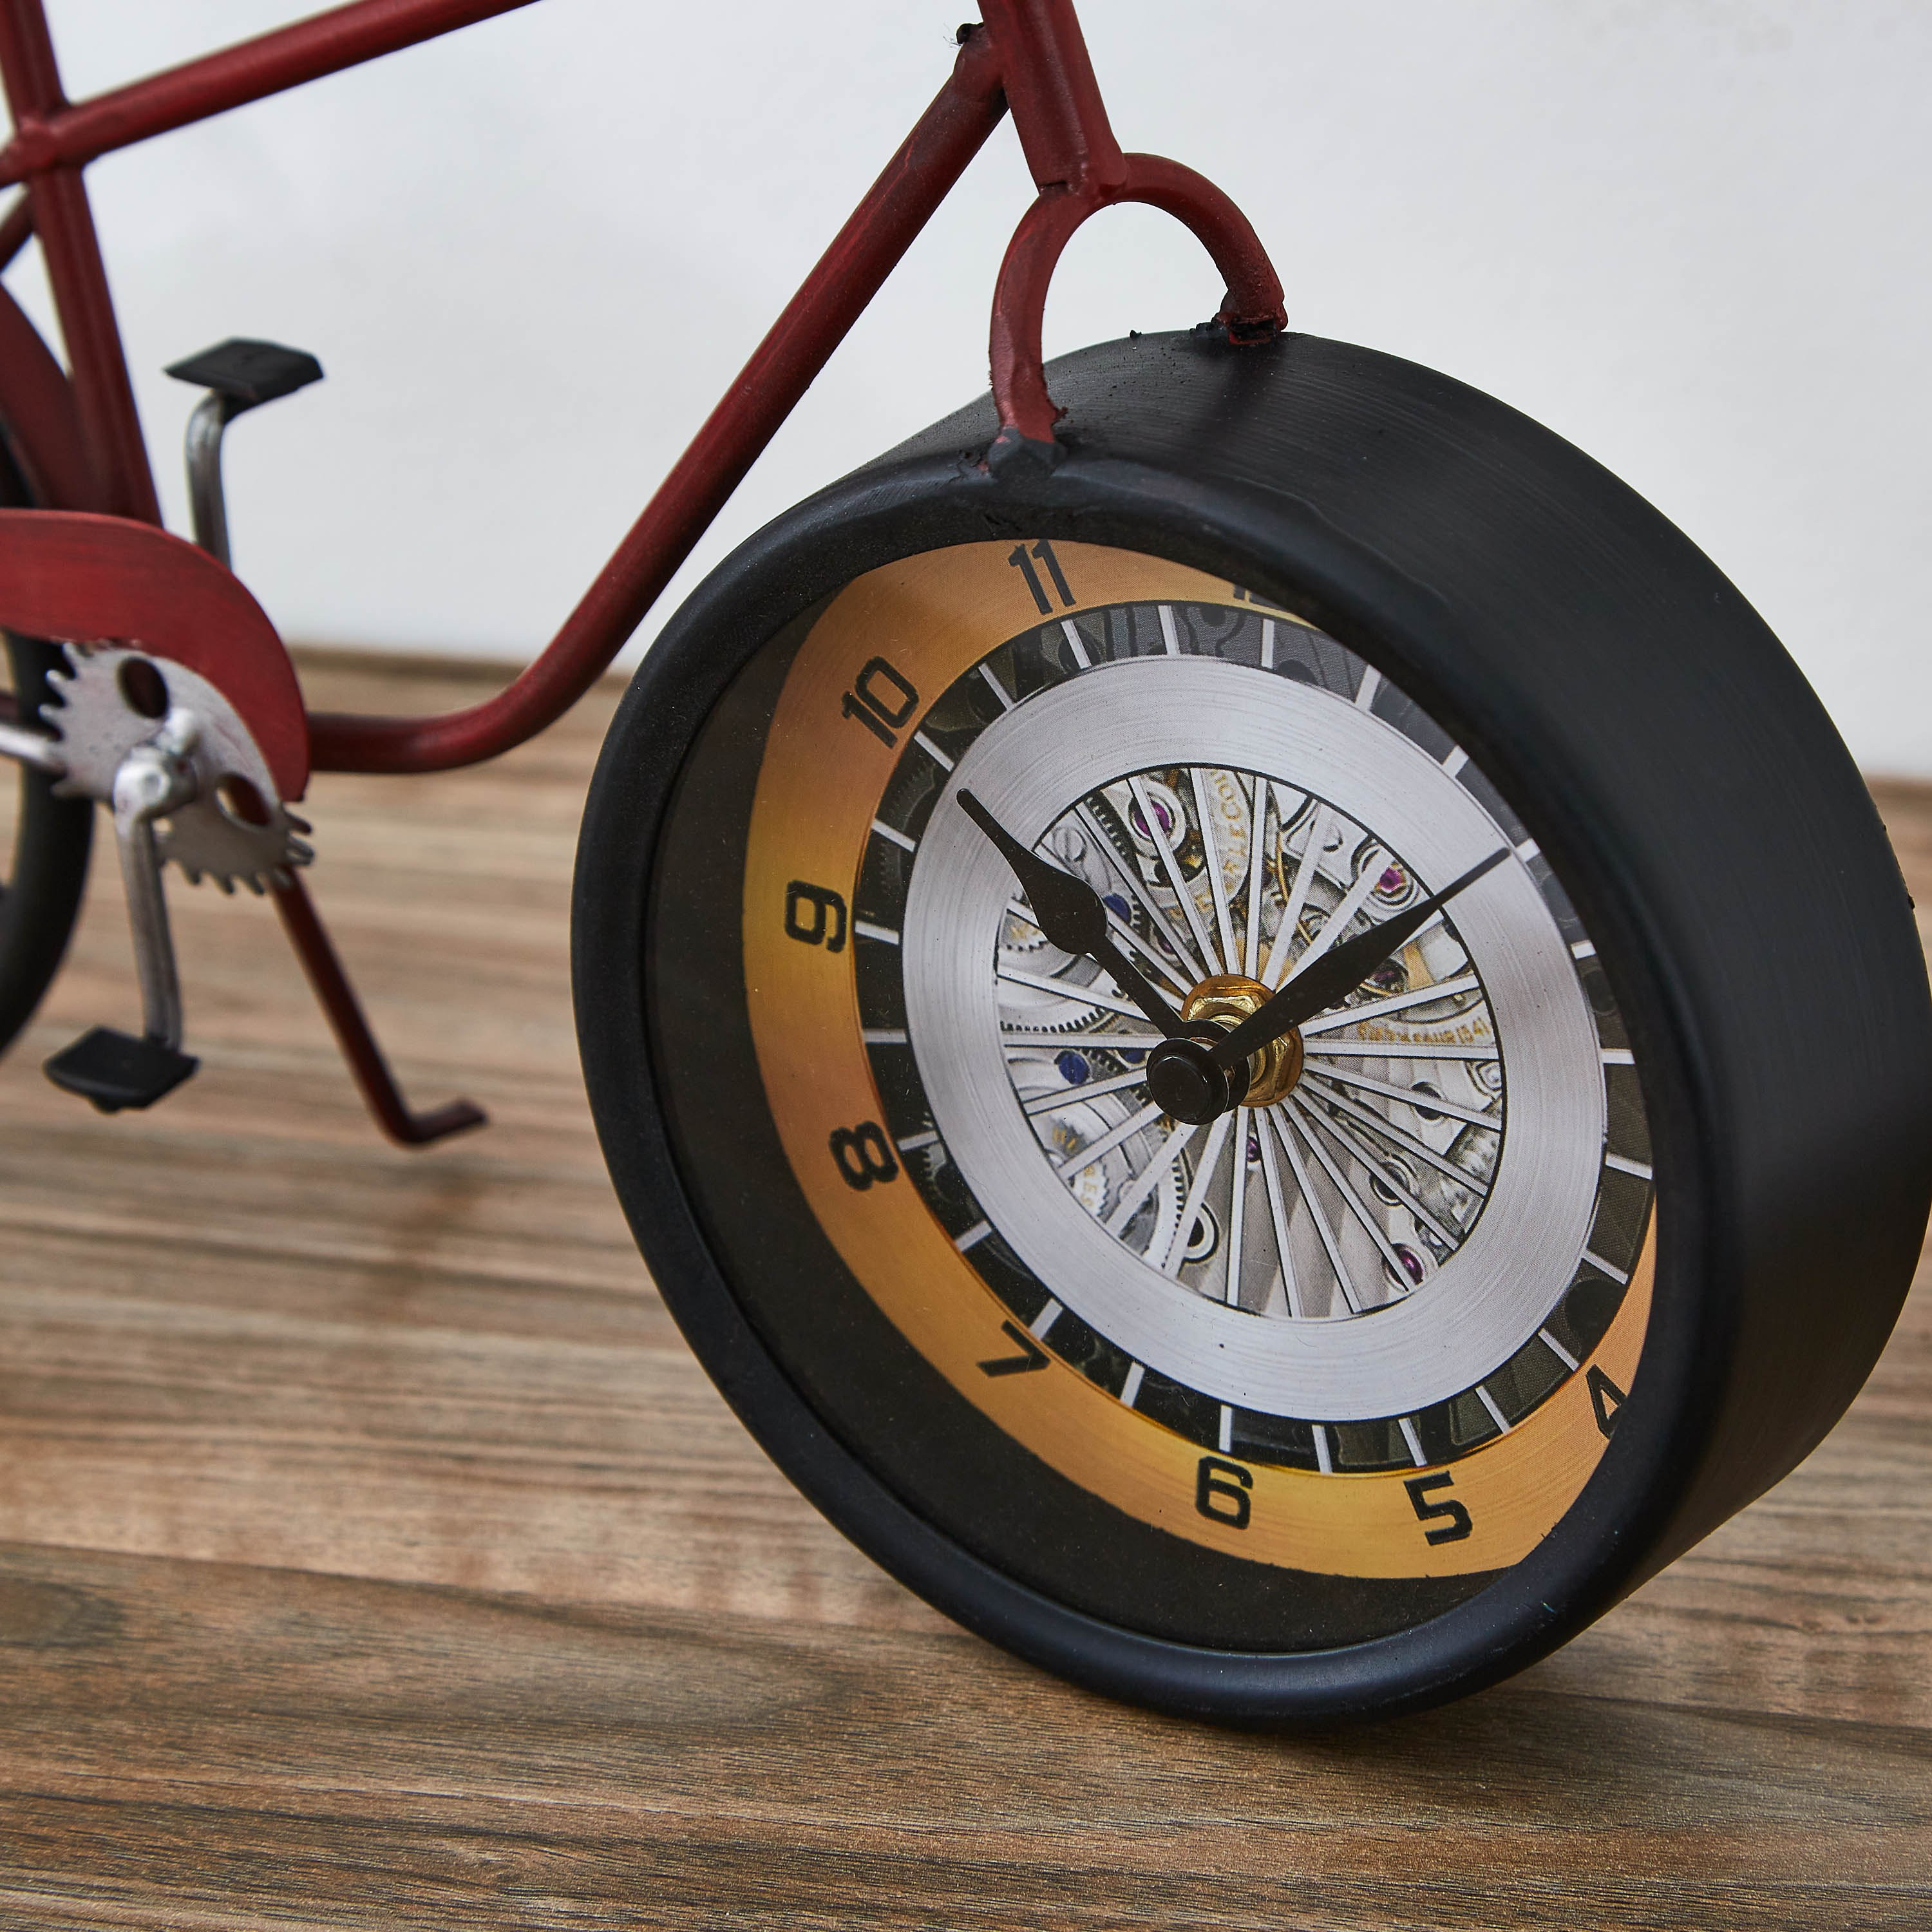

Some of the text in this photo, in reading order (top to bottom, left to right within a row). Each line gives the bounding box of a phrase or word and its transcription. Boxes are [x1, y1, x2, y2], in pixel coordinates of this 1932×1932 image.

[1009, 539, 1075, 615] 11
[842, 656, 919, 749] 10
[785, 879, 847, 953] 9
[829, 1121, 900, 1191] 8
[977, 1320, 1051, 1378] 7
[1586, 1363, 1628, 1440] 4
[1196, 1455, 1253, 1530] 6
[1404, 1472, 1473, 1546] 5
